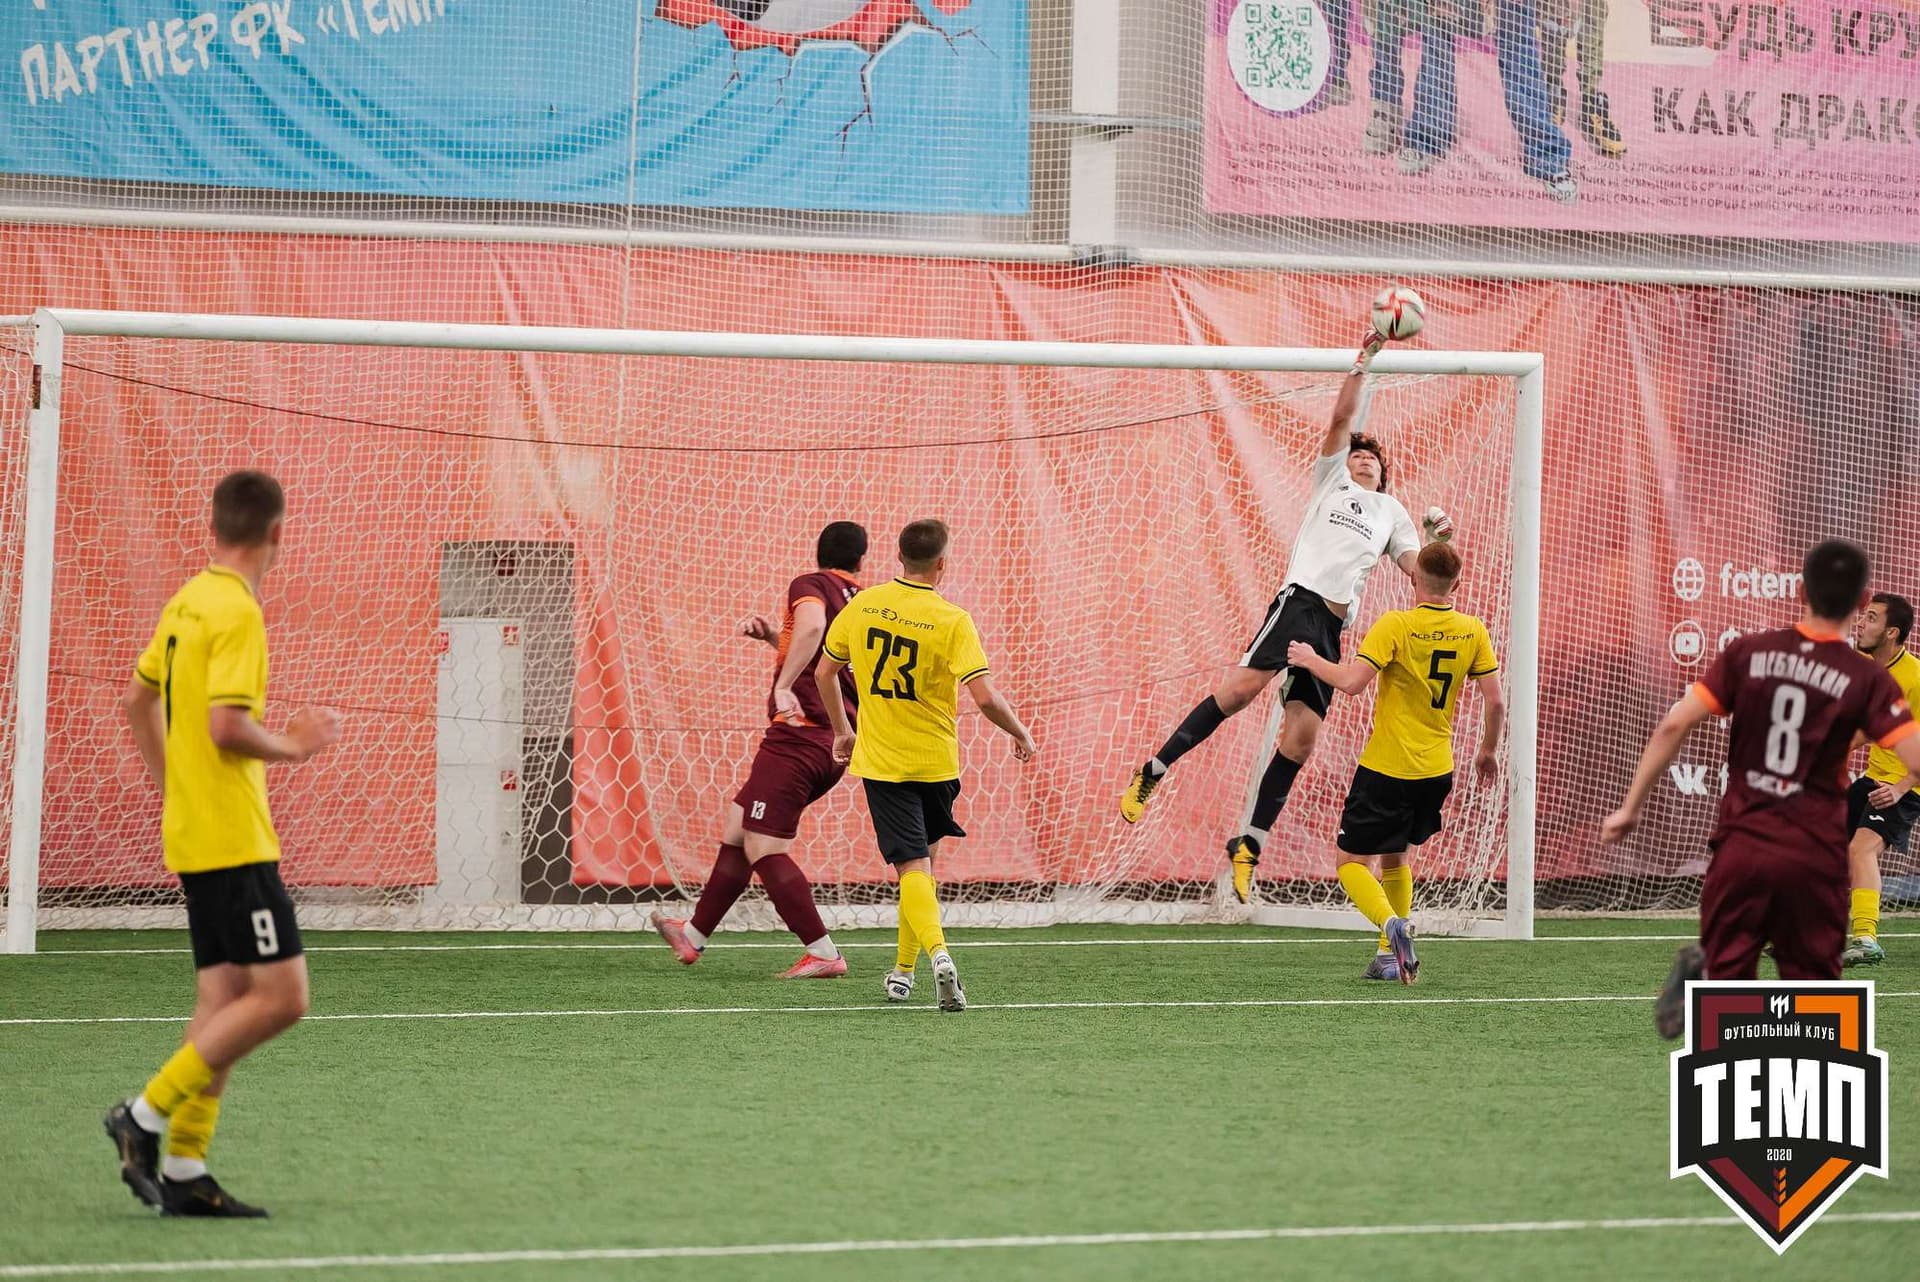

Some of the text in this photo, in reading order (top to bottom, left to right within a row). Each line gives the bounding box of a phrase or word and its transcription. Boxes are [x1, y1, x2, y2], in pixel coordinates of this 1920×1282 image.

[20, 12, 218, 106] ПАРТНЕР
[231, 0, 305, 59] ФК
[1650, 0, 1816, 62] БУДЬ
[1652, 86, 1760, 138] КАК
[1719, 562, 1806, 599] fctem
[866, 627, 919, 702] 23
[1428, 650, 1457, 710] 5
[1765, 684, 1807, 776] 8
[751, 800, 767, 820] 13
[251, 908, 280, 957] 9
